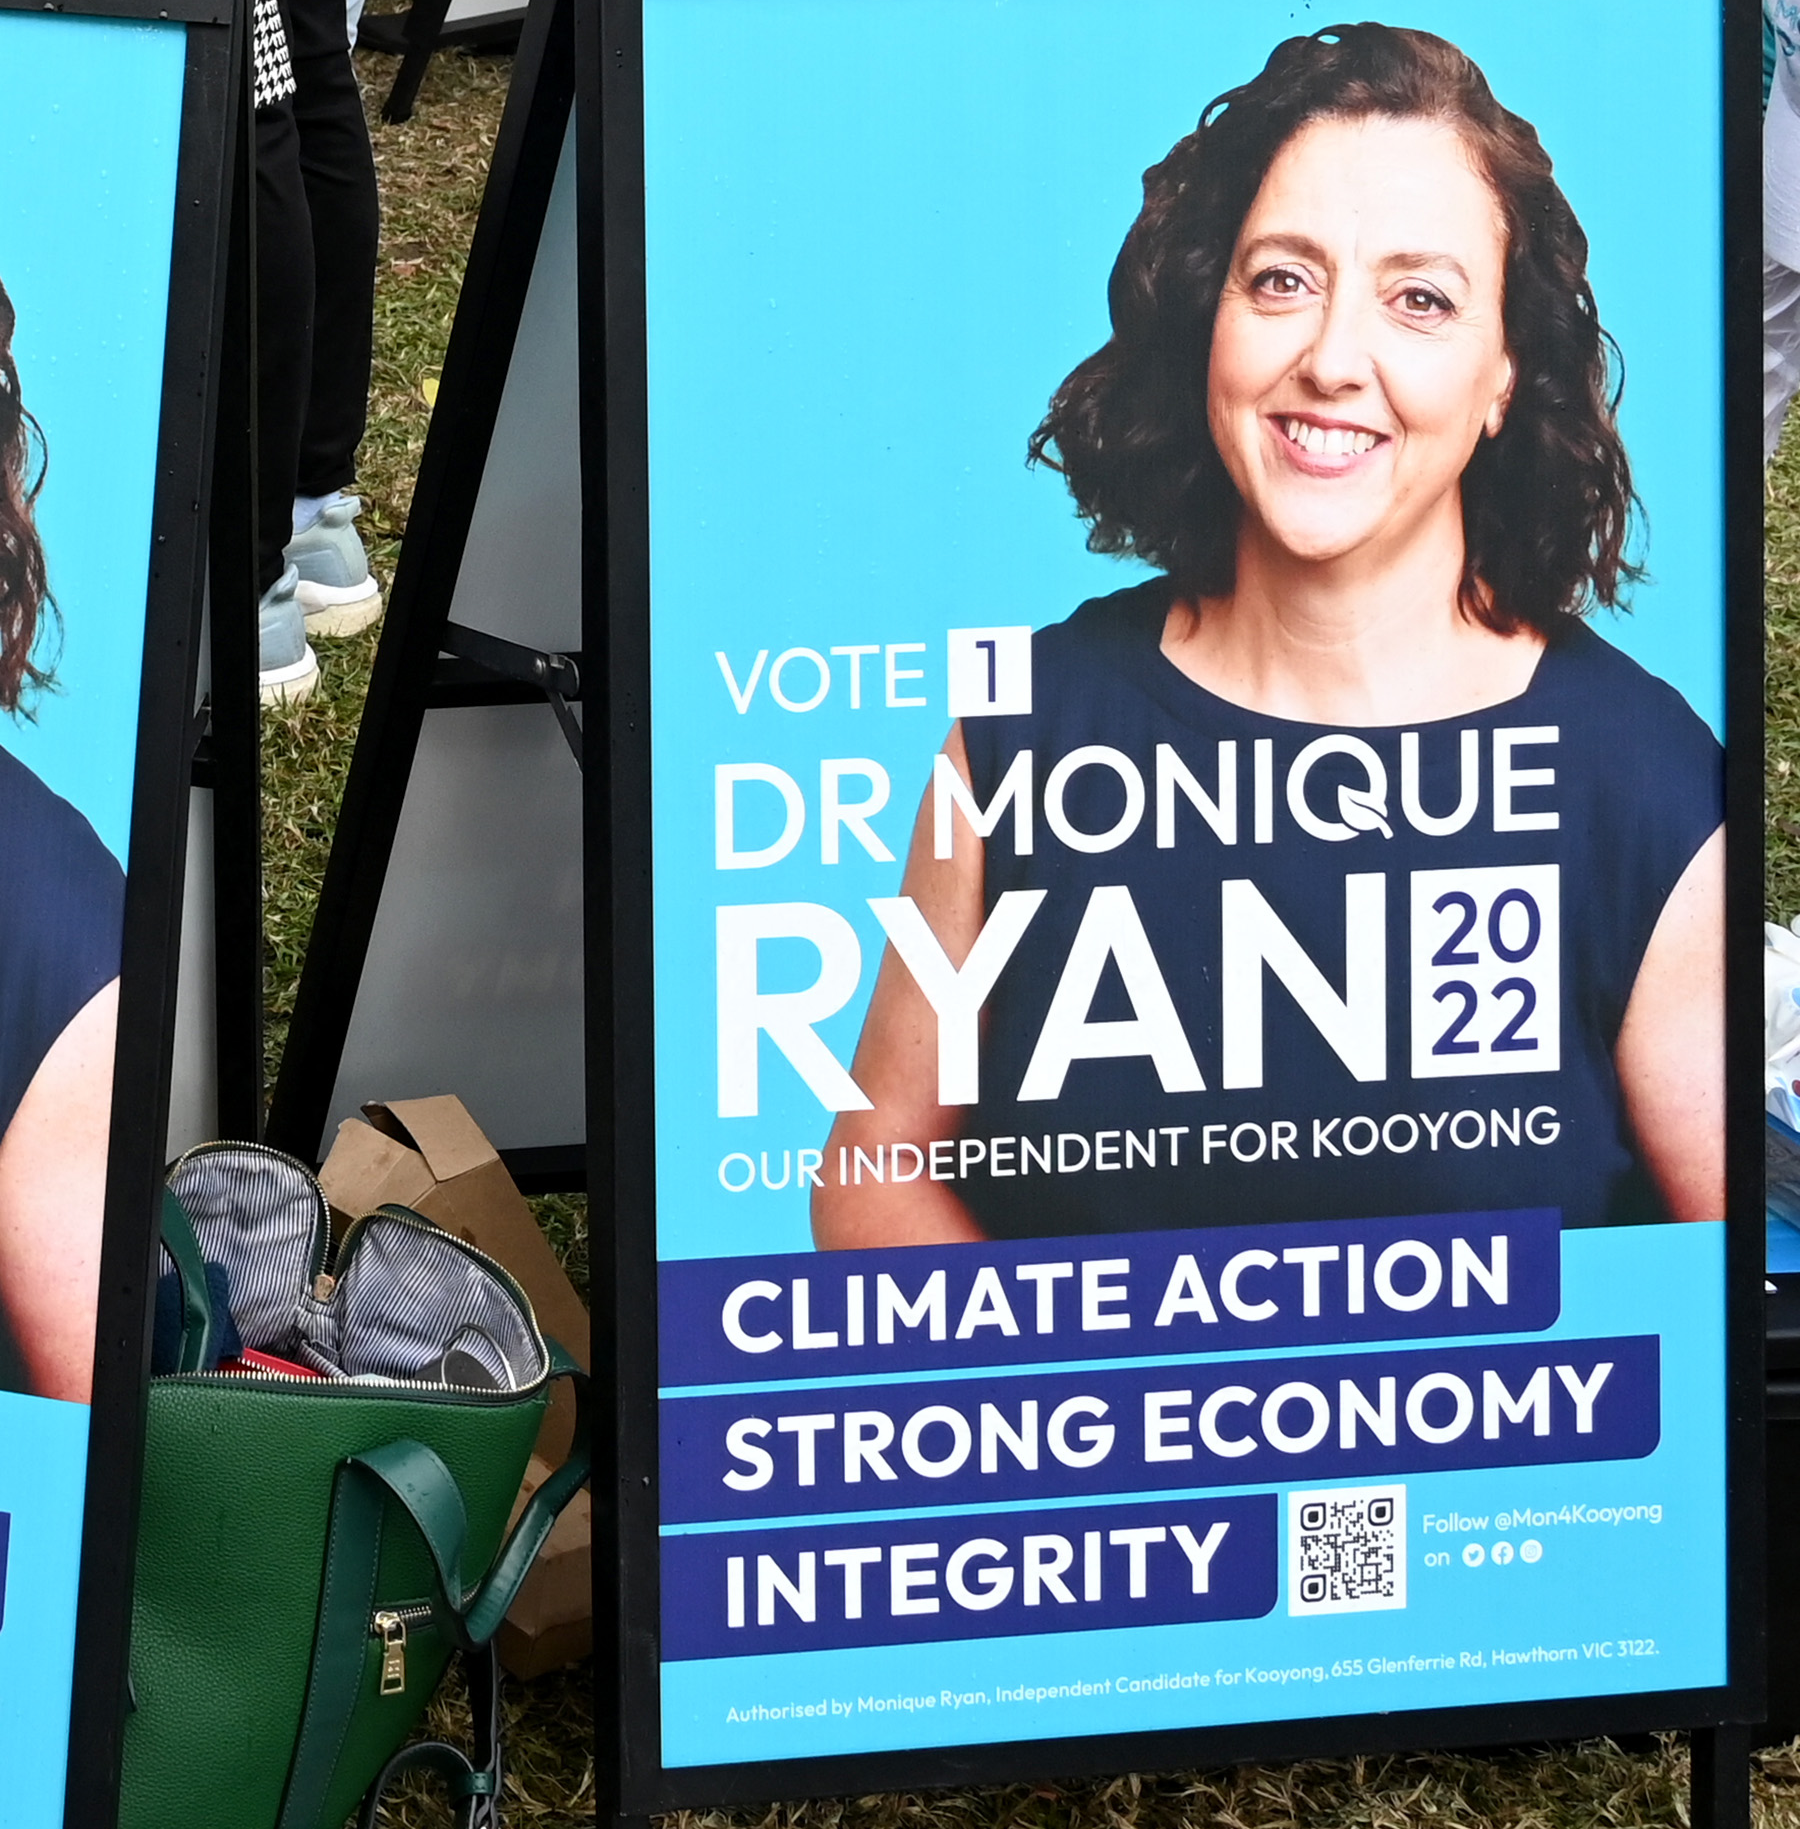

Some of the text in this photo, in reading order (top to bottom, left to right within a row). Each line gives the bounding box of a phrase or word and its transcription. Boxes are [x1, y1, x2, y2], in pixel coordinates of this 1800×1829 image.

[716, 638, 1000, 714] VOTE 1
[716, 726, 1559, 869] DR MONIQUE
[1432, 889, 1540, 966] 20
[717, 873, 1386, 1117] RYAN
[1433, 978, 1537, 1055] 22
[719, 1106, 1560, 1191] OUR INDEPENDENT FOR KOOYONG
[723, 1236, 1507, 1352] CLIMATE ACTION
[723, 1363, 1613, 1490] STRONG ECONOMY
[1422, 1504, 1663, 1534] Follow @Mon4Kooyong
[1424, 1551, 1450, 1567] on
[728, 1523, 1229, 1627] INTEGRITY
[726, 1637, 1661, 1724] Authorised by Monique Ryan, Independent Candidate for Kooyong, 655 Glenferrie Rd, Hawthorn VIC 3122.
